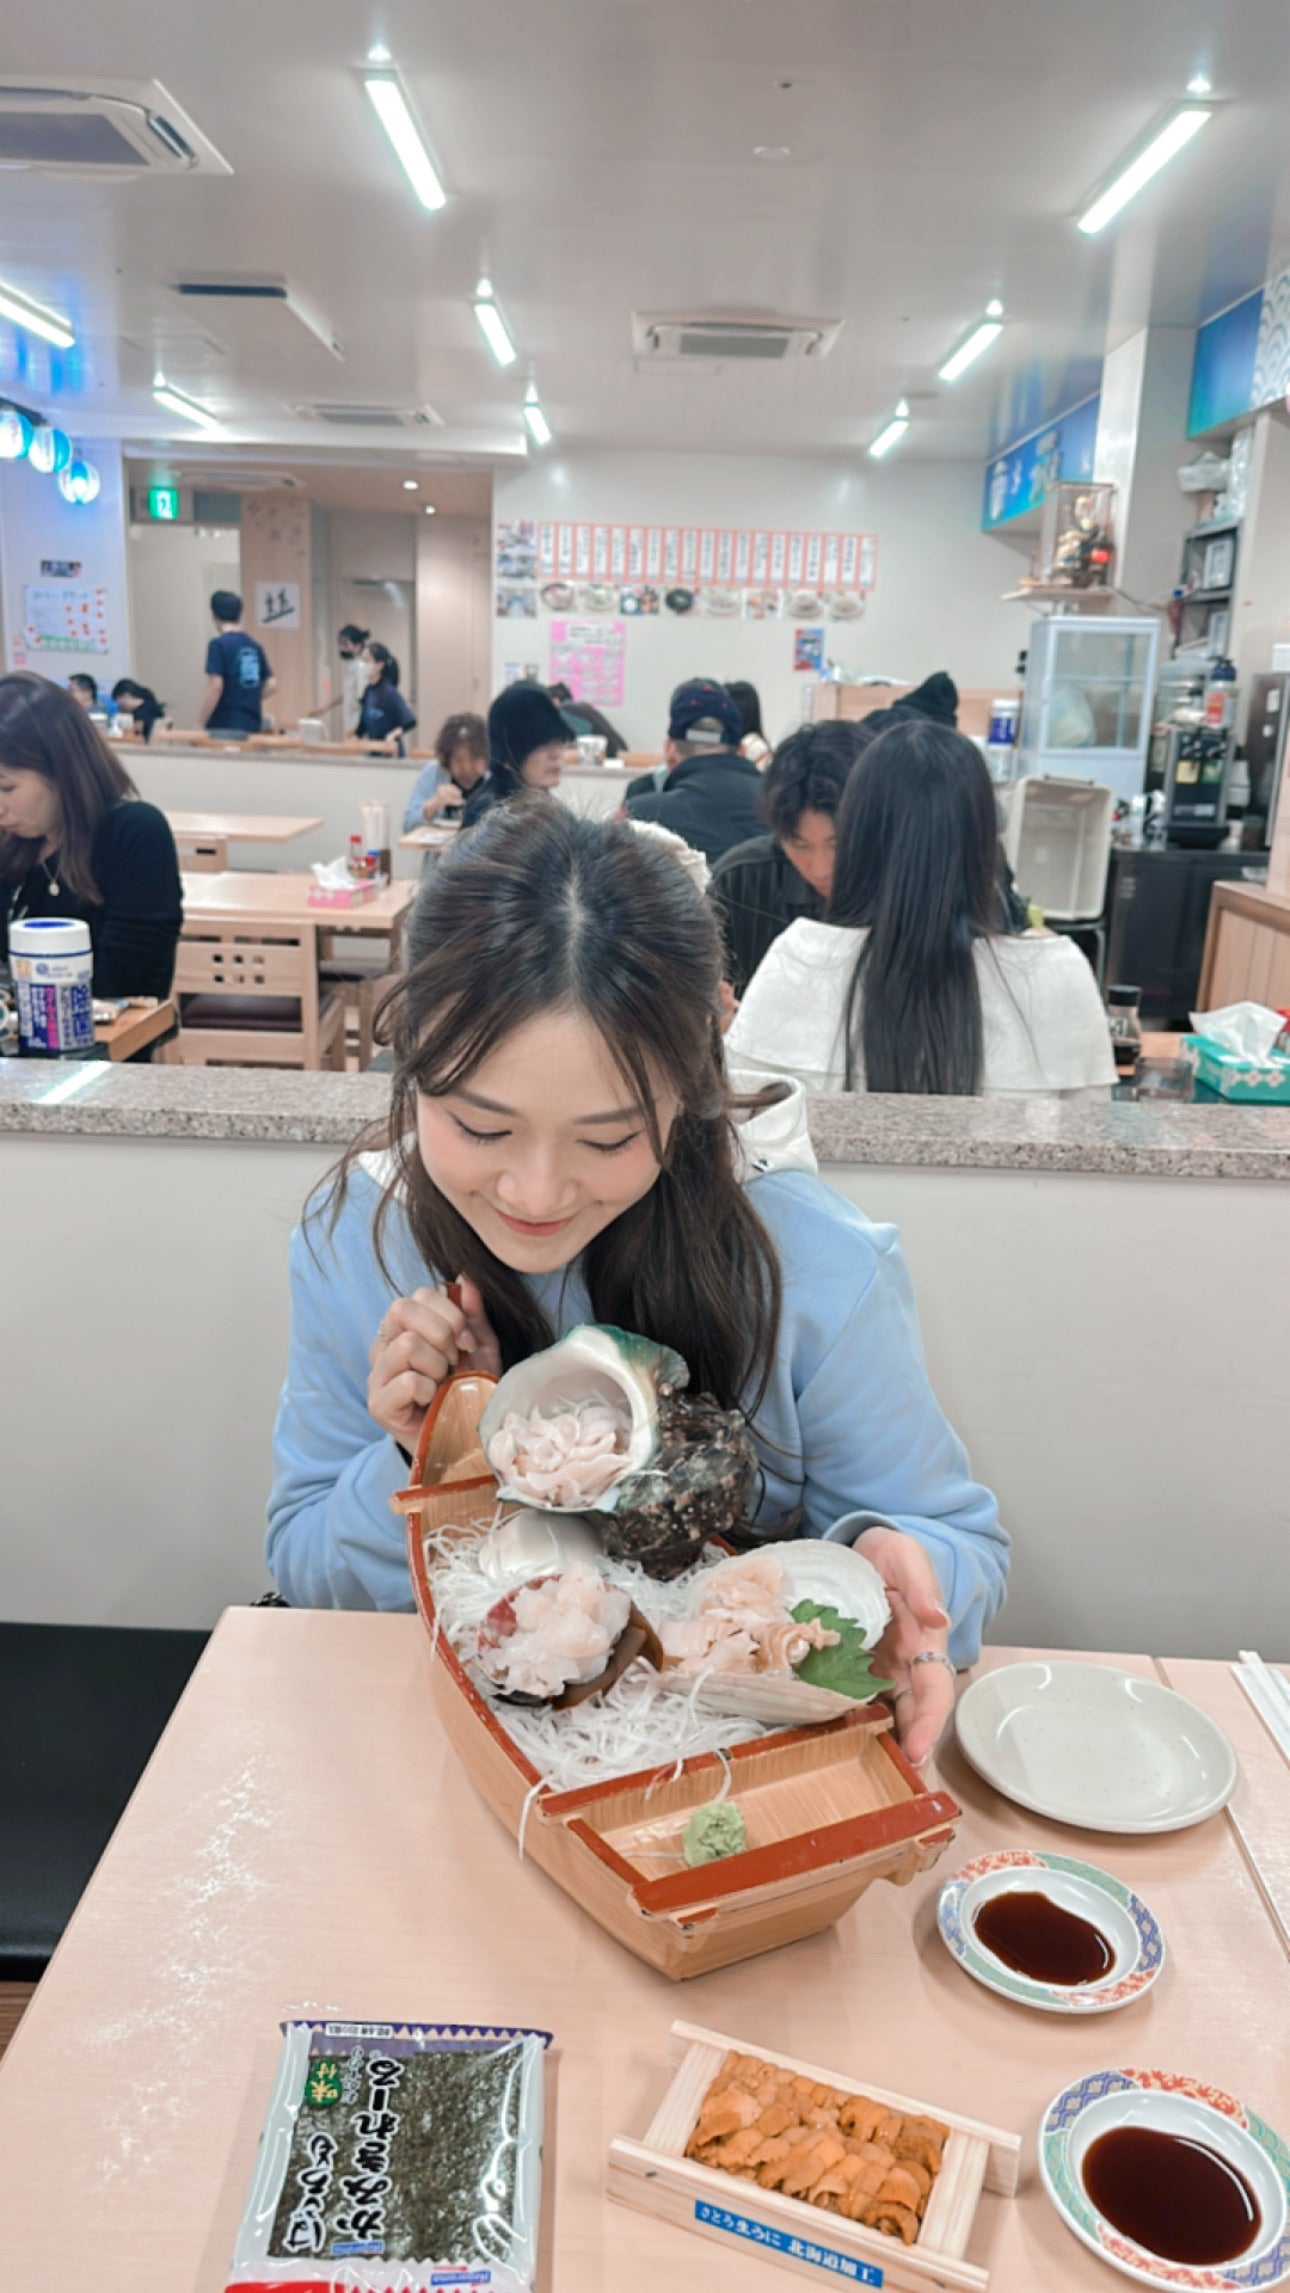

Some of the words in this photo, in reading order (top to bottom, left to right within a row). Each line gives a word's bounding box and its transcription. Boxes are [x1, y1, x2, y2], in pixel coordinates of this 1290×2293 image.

[309, 2062, 338, 2104] 味付
[285, 2134, 336, 2249] はごろも
